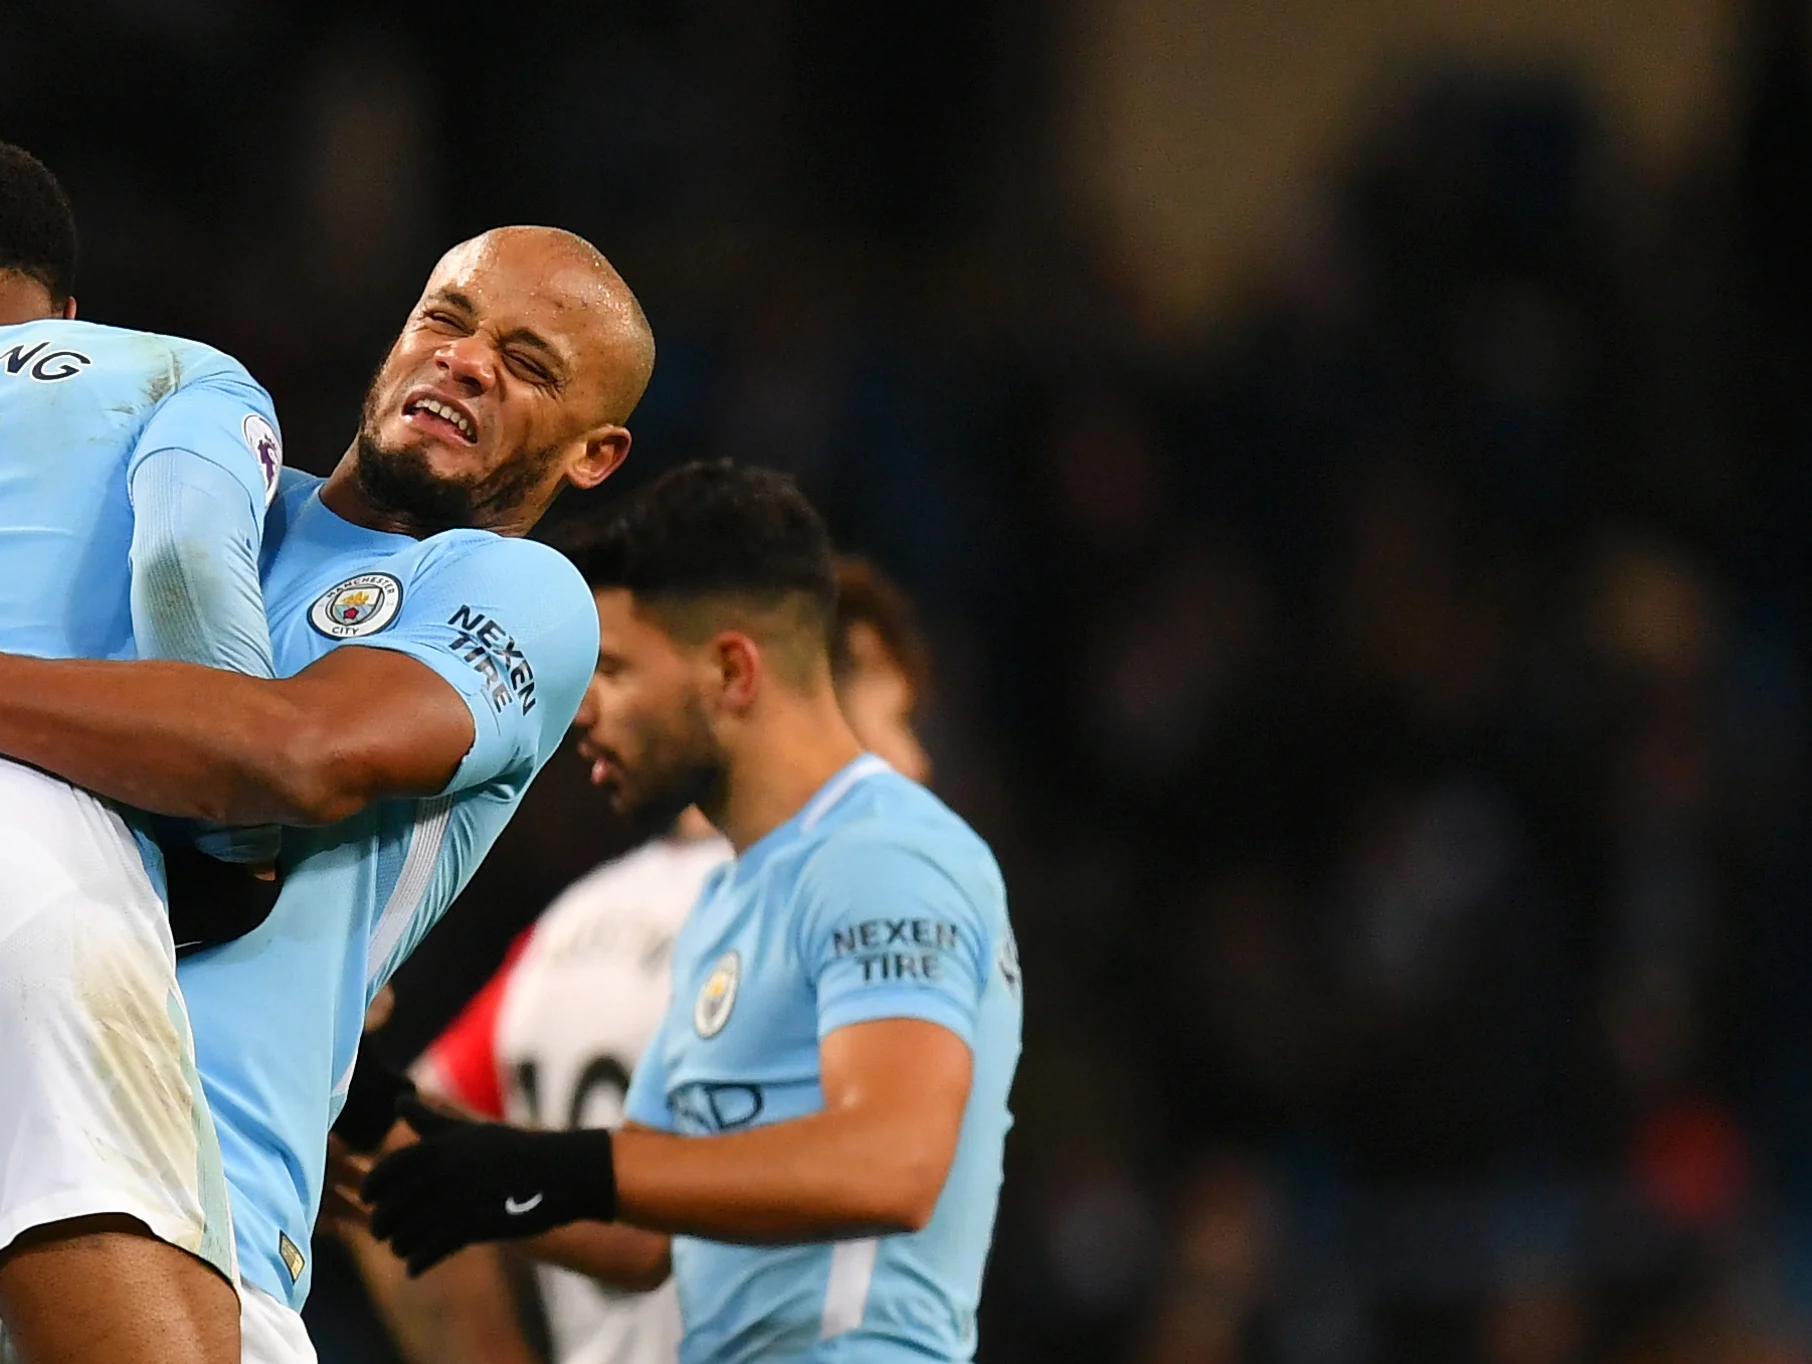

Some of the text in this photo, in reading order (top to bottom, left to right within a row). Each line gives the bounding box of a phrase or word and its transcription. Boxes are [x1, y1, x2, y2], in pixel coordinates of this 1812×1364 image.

[331, 625, 360, 636] CITY
[448, 604, 537, 717] NEXEN
[448, 630, 513, 714] TIRE
[832, 916, 958, 957] NEXEN
[856, 952, 940, 983] TIRE
